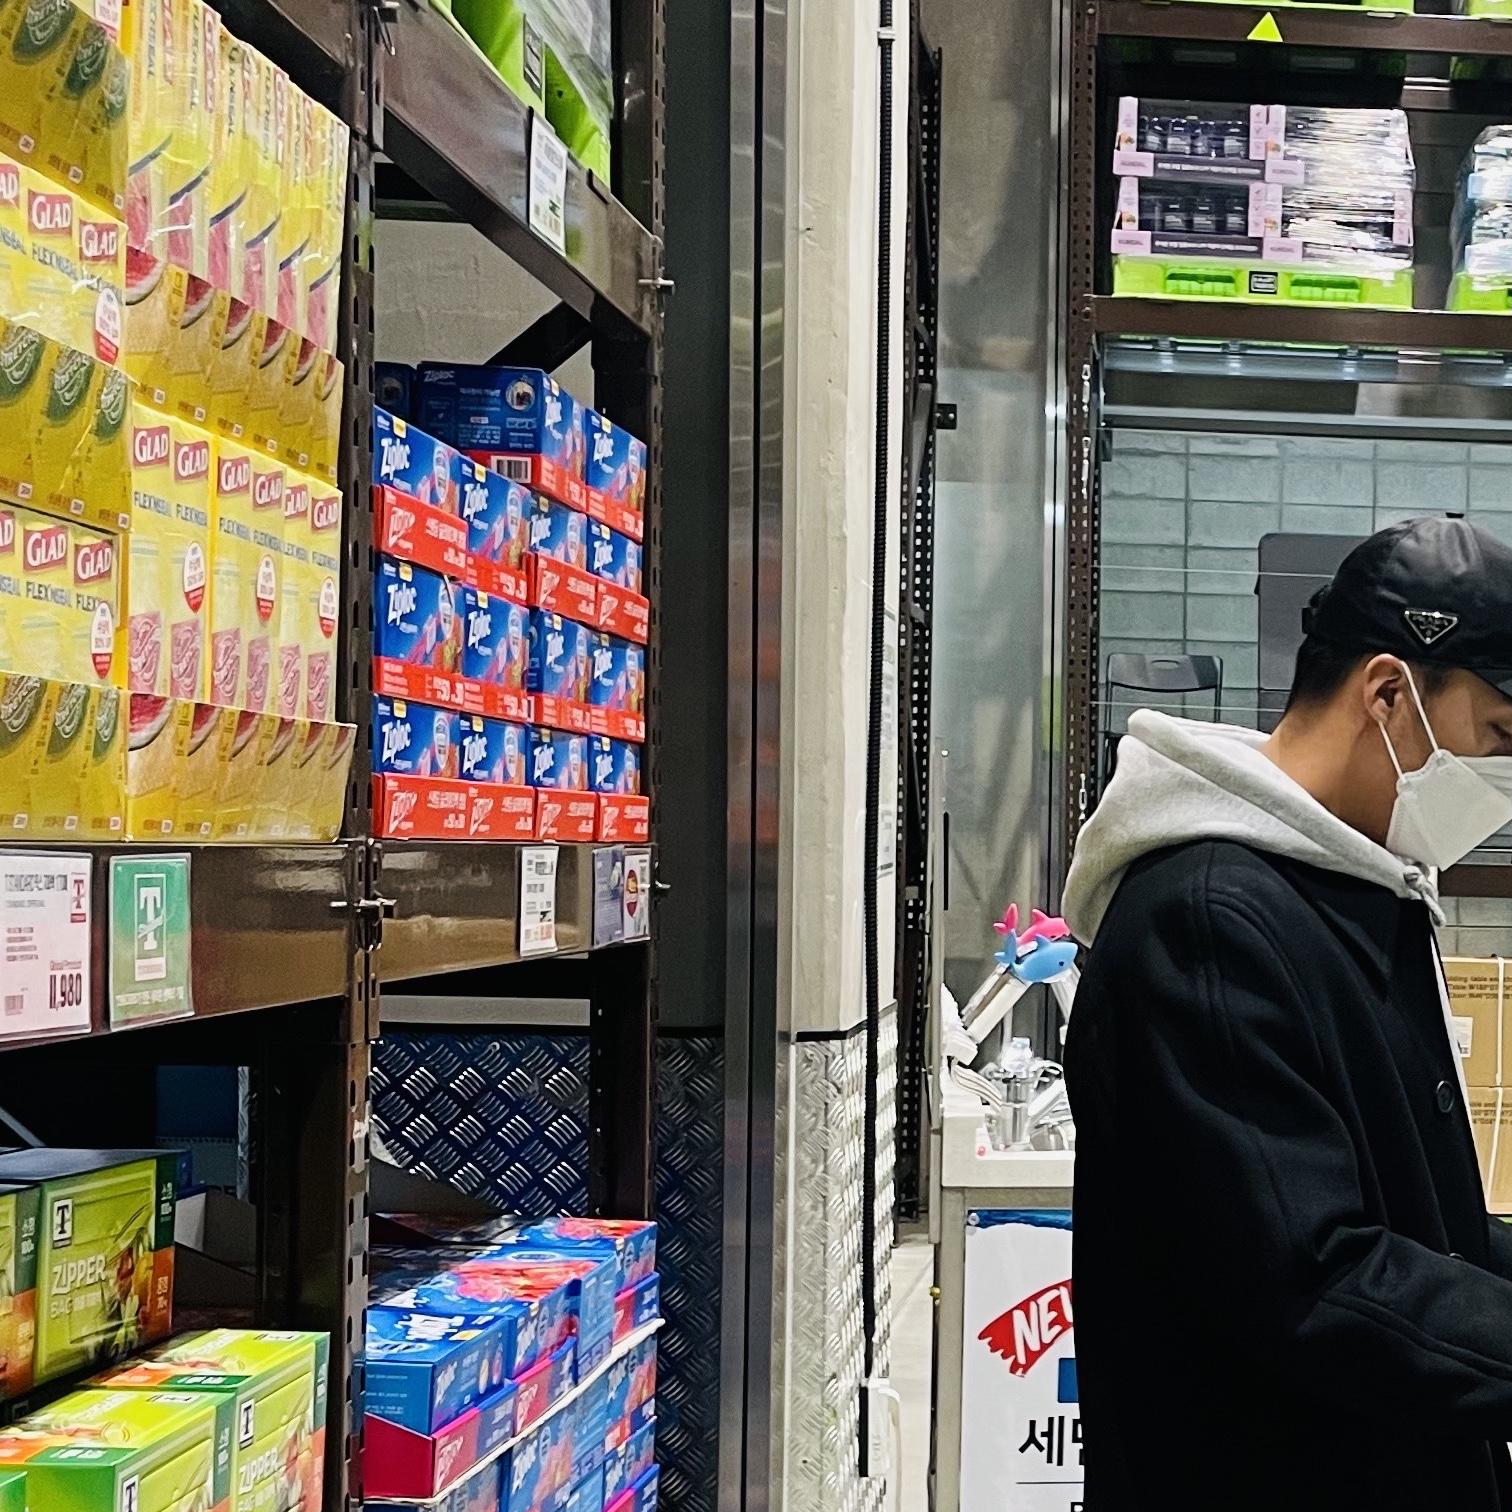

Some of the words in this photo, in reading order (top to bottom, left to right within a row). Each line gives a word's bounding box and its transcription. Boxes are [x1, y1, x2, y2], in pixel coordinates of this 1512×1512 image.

[0, 178, 18, 198] AD
[32, 196, 71, 230] GLAD
[81, 224, 117, 257] GLAD
[135, 430, 169, 464] GLAD
[178, 445, 208, 477] GLAD
[221, 460, 249, 491] GLAD
[256, 474, 283, 505] GLAD
[314, 501, 338, 529] GLAD
[0, 519, 14, 545] AD
[27, 532, 67, 567] GLAD
[77, 549, 111, 582] GLAD
[388, 583, 417, 626] Ziploc
[381, 720, 411, 763] Ziploc
[52, 1254, 107, 1295] ZIPPER
[238, 1450, 279, 1497] ZIPPER
